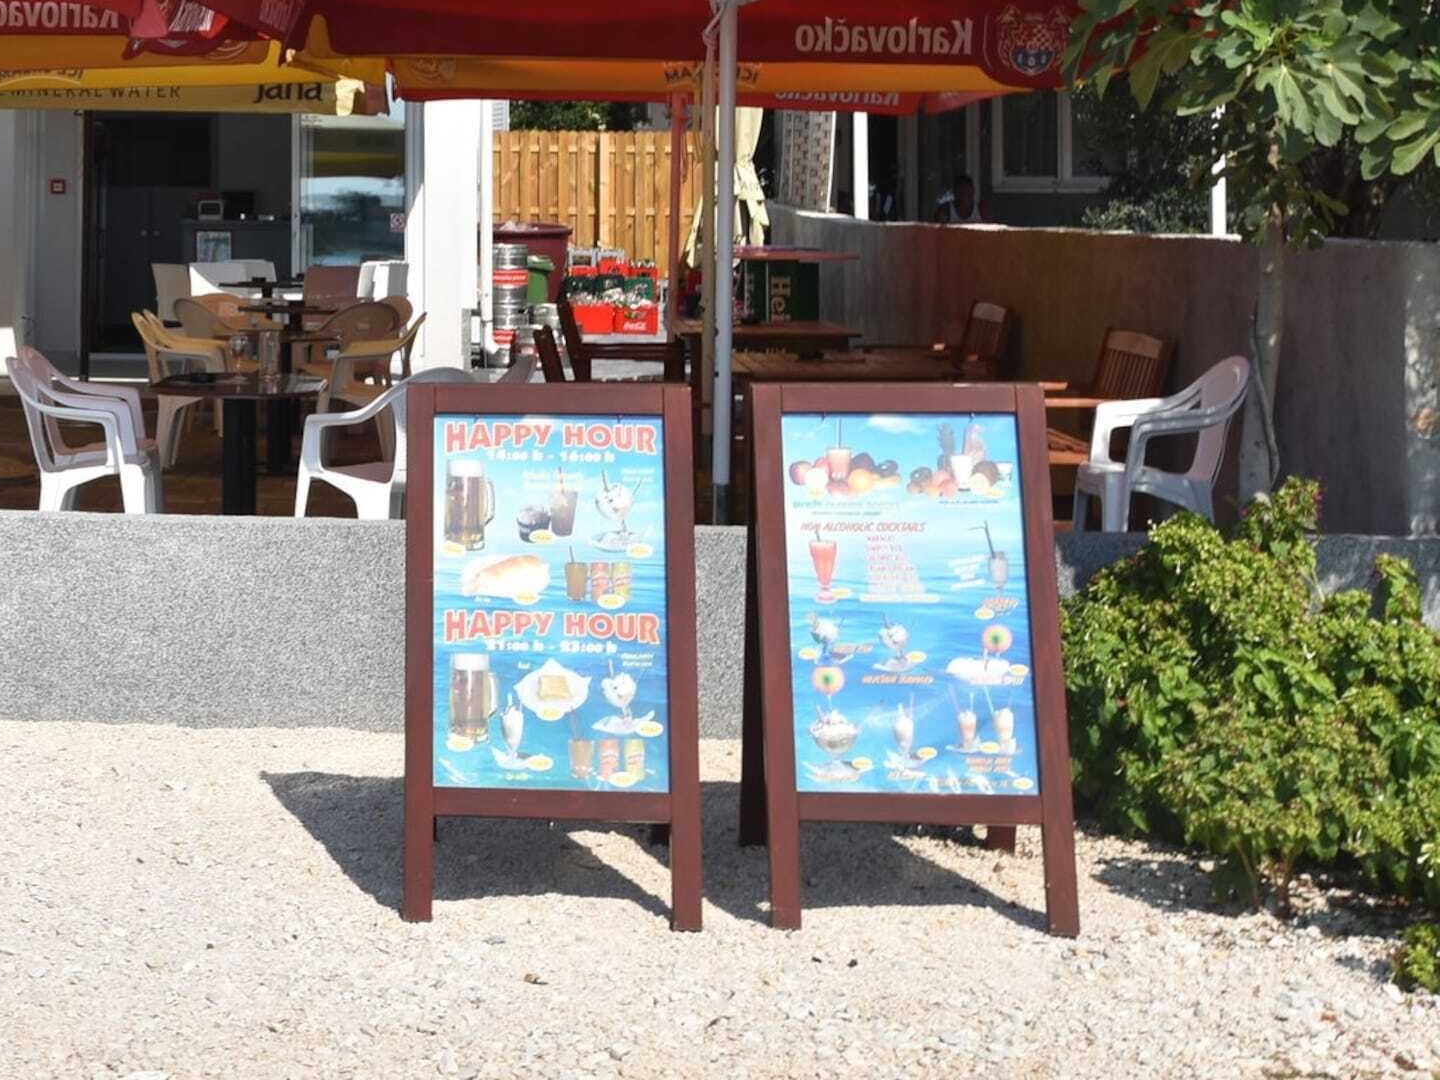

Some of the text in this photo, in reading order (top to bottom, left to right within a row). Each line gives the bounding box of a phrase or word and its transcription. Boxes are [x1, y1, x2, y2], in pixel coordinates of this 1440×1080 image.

[444, 422, 658, 455] HAPPY HOUR
[444, 610, 660, 644] HAPPY HOUR
